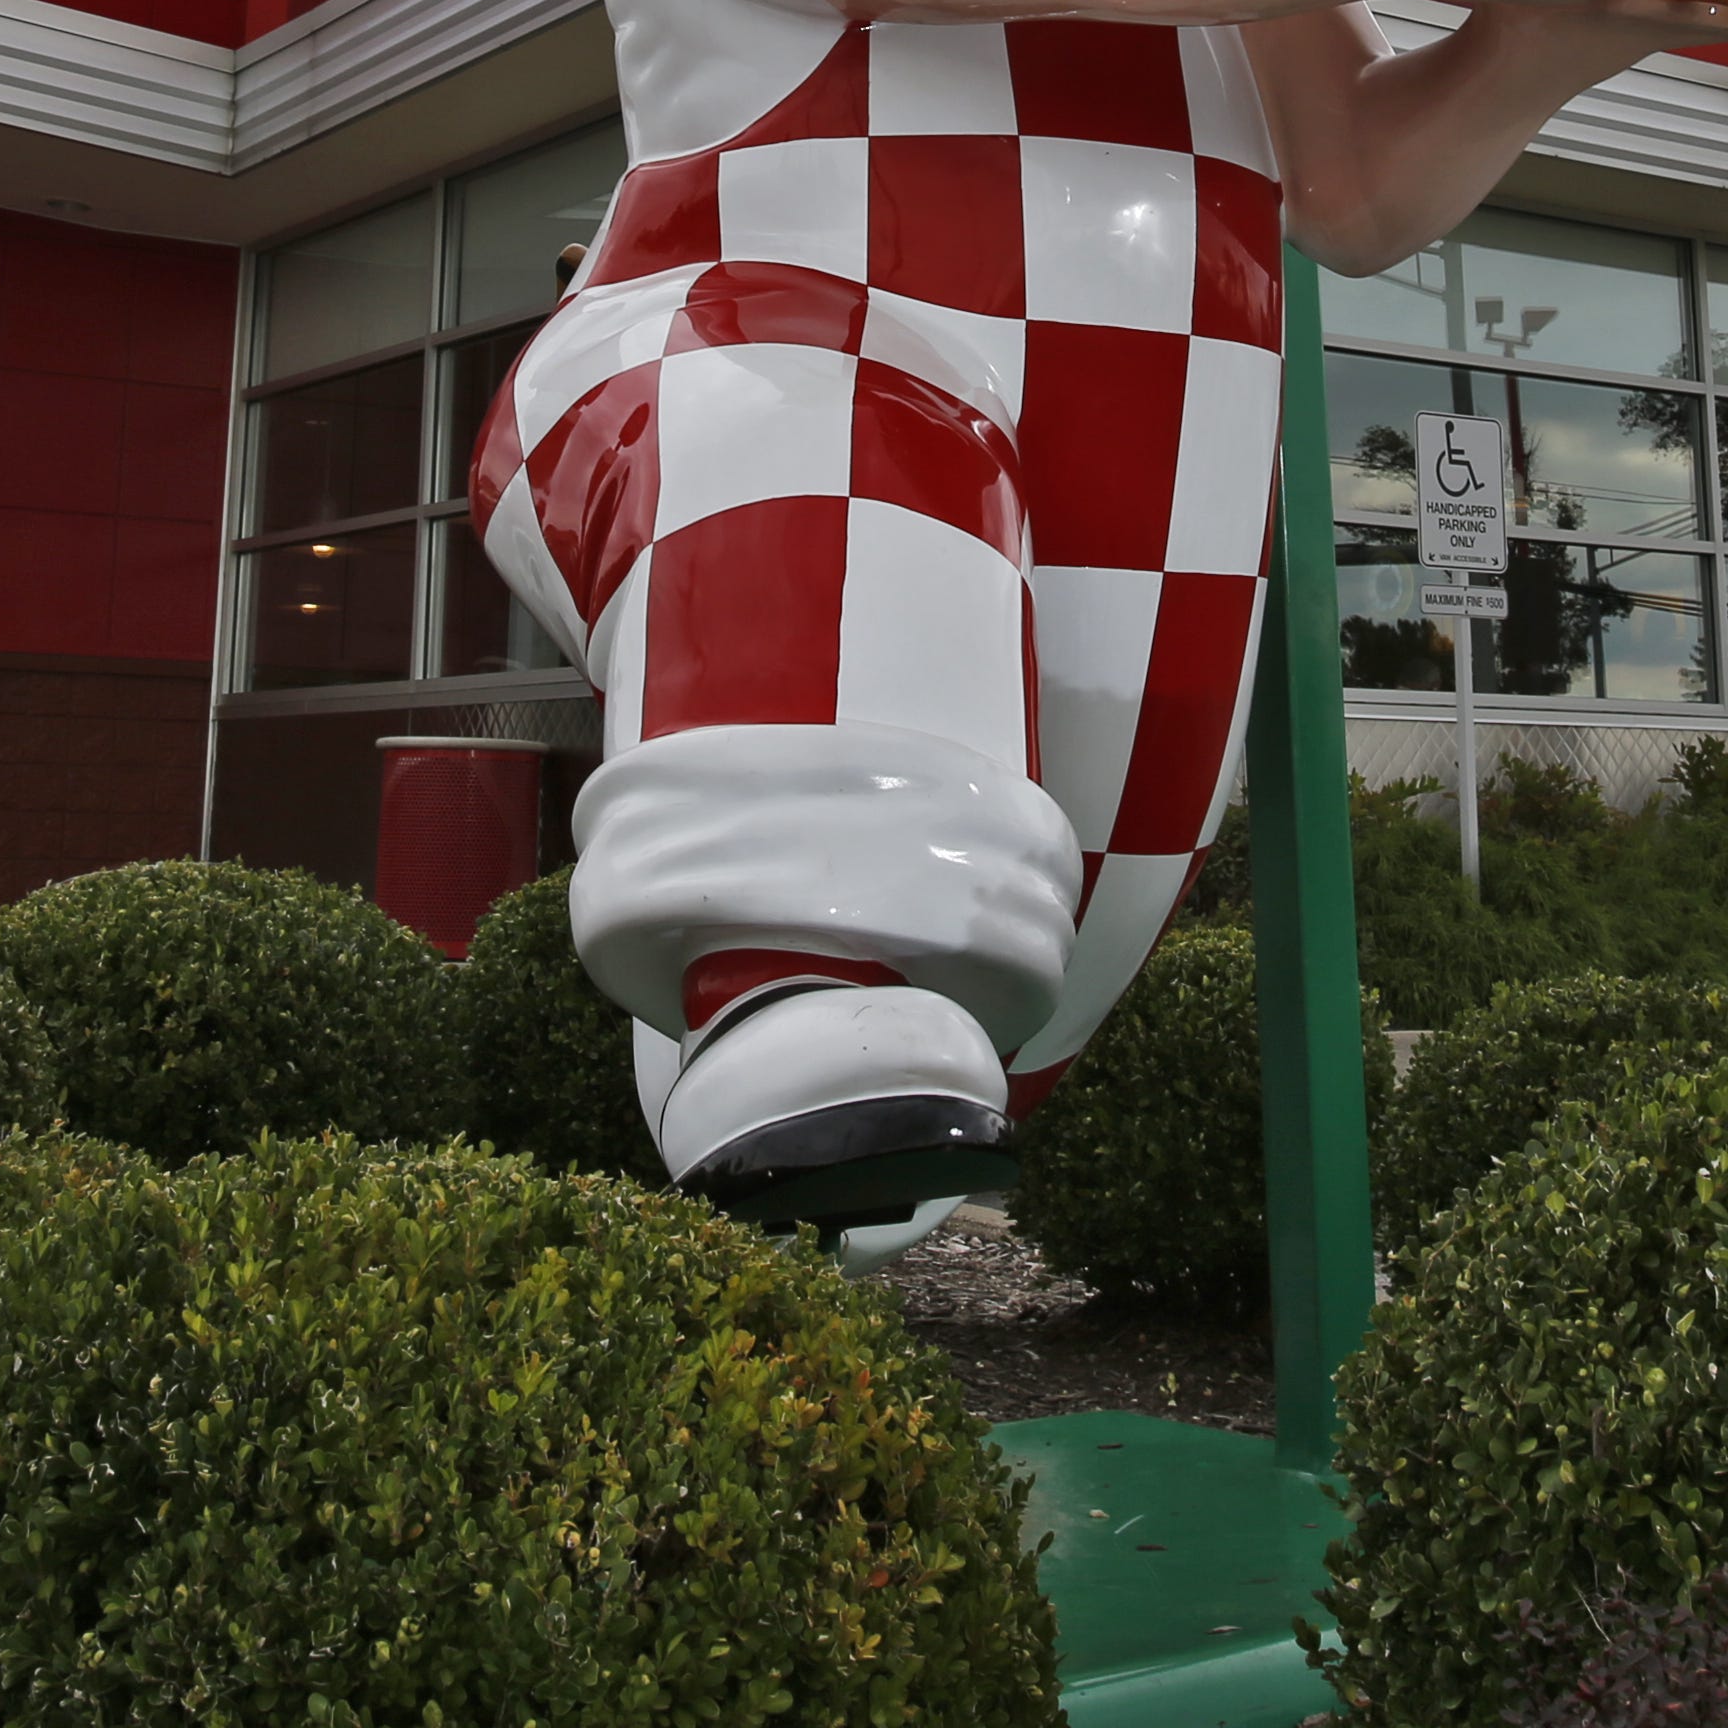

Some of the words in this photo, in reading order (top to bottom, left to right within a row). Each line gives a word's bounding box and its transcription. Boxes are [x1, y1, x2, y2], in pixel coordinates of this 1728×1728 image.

[1426, 501, 1498, 519] HANDICAPPED
[1438, 517, 1487, 534] PARKING
[1450, 534, 1476, 548] ONLY
[1439, 554, 1452, 562] VAN
[1425, 593, 1464, 607] MAXIMUM
[1466, 595, 1483, 608] FINE
[1485, 596, 1504, 610] $500
